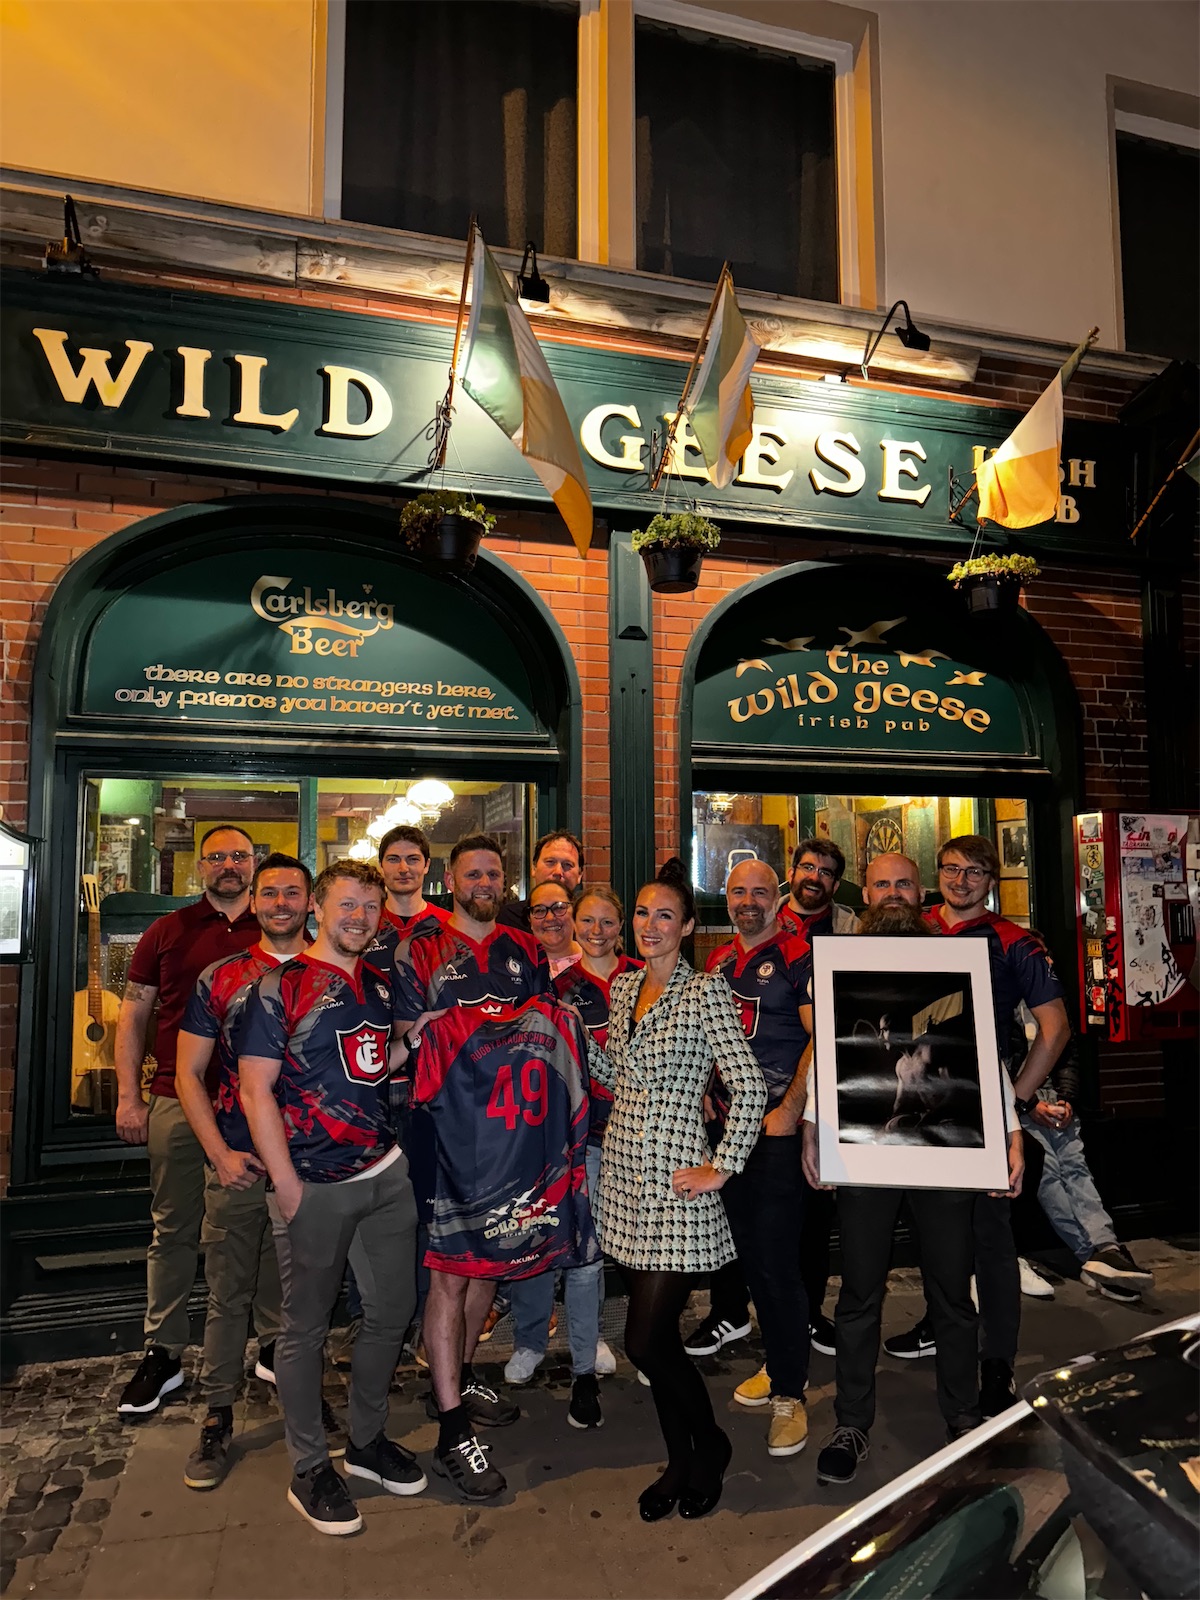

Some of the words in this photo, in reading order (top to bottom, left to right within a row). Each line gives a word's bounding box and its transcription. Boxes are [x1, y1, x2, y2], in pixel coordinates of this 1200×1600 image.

[32, 327, 393, 438] WILD
[579, 403, 932, 505] GEESE
[250, 575, 395, 630] Carlsberg
[289, 625, 364, 658] Beer
[825, 644, 890, 676] the
[143, 664, 220, 684] there
[224, 669, 271, 686] are
[276, 674, 309, 689] no
[313, 675, 433, 697] strangers
[436, 681, 497, 700] here,
[114, 686, 173, 707] only
[177, 689, 277, 711] friends
[280, 695, 326, 714] you
[427, 701, 464, 720] yet
[468, 704, 519, 721] met.
[727, 671, 839, 723] wild
[853, 680, 992, 734] geese
[798, 713, 869, 729] irish
[885, 718, 931, 734] pub
[438, 973, 469, 982] AKUMA
[314, 1001, 345, 1012] AKUMA
[470, 1041, 495, 1063] RUGBY
[485, 1059, 549, 1131] 49
[483, 1218, 519, 1240] wild
[510, 1253, 540, 1265] AKUMA
